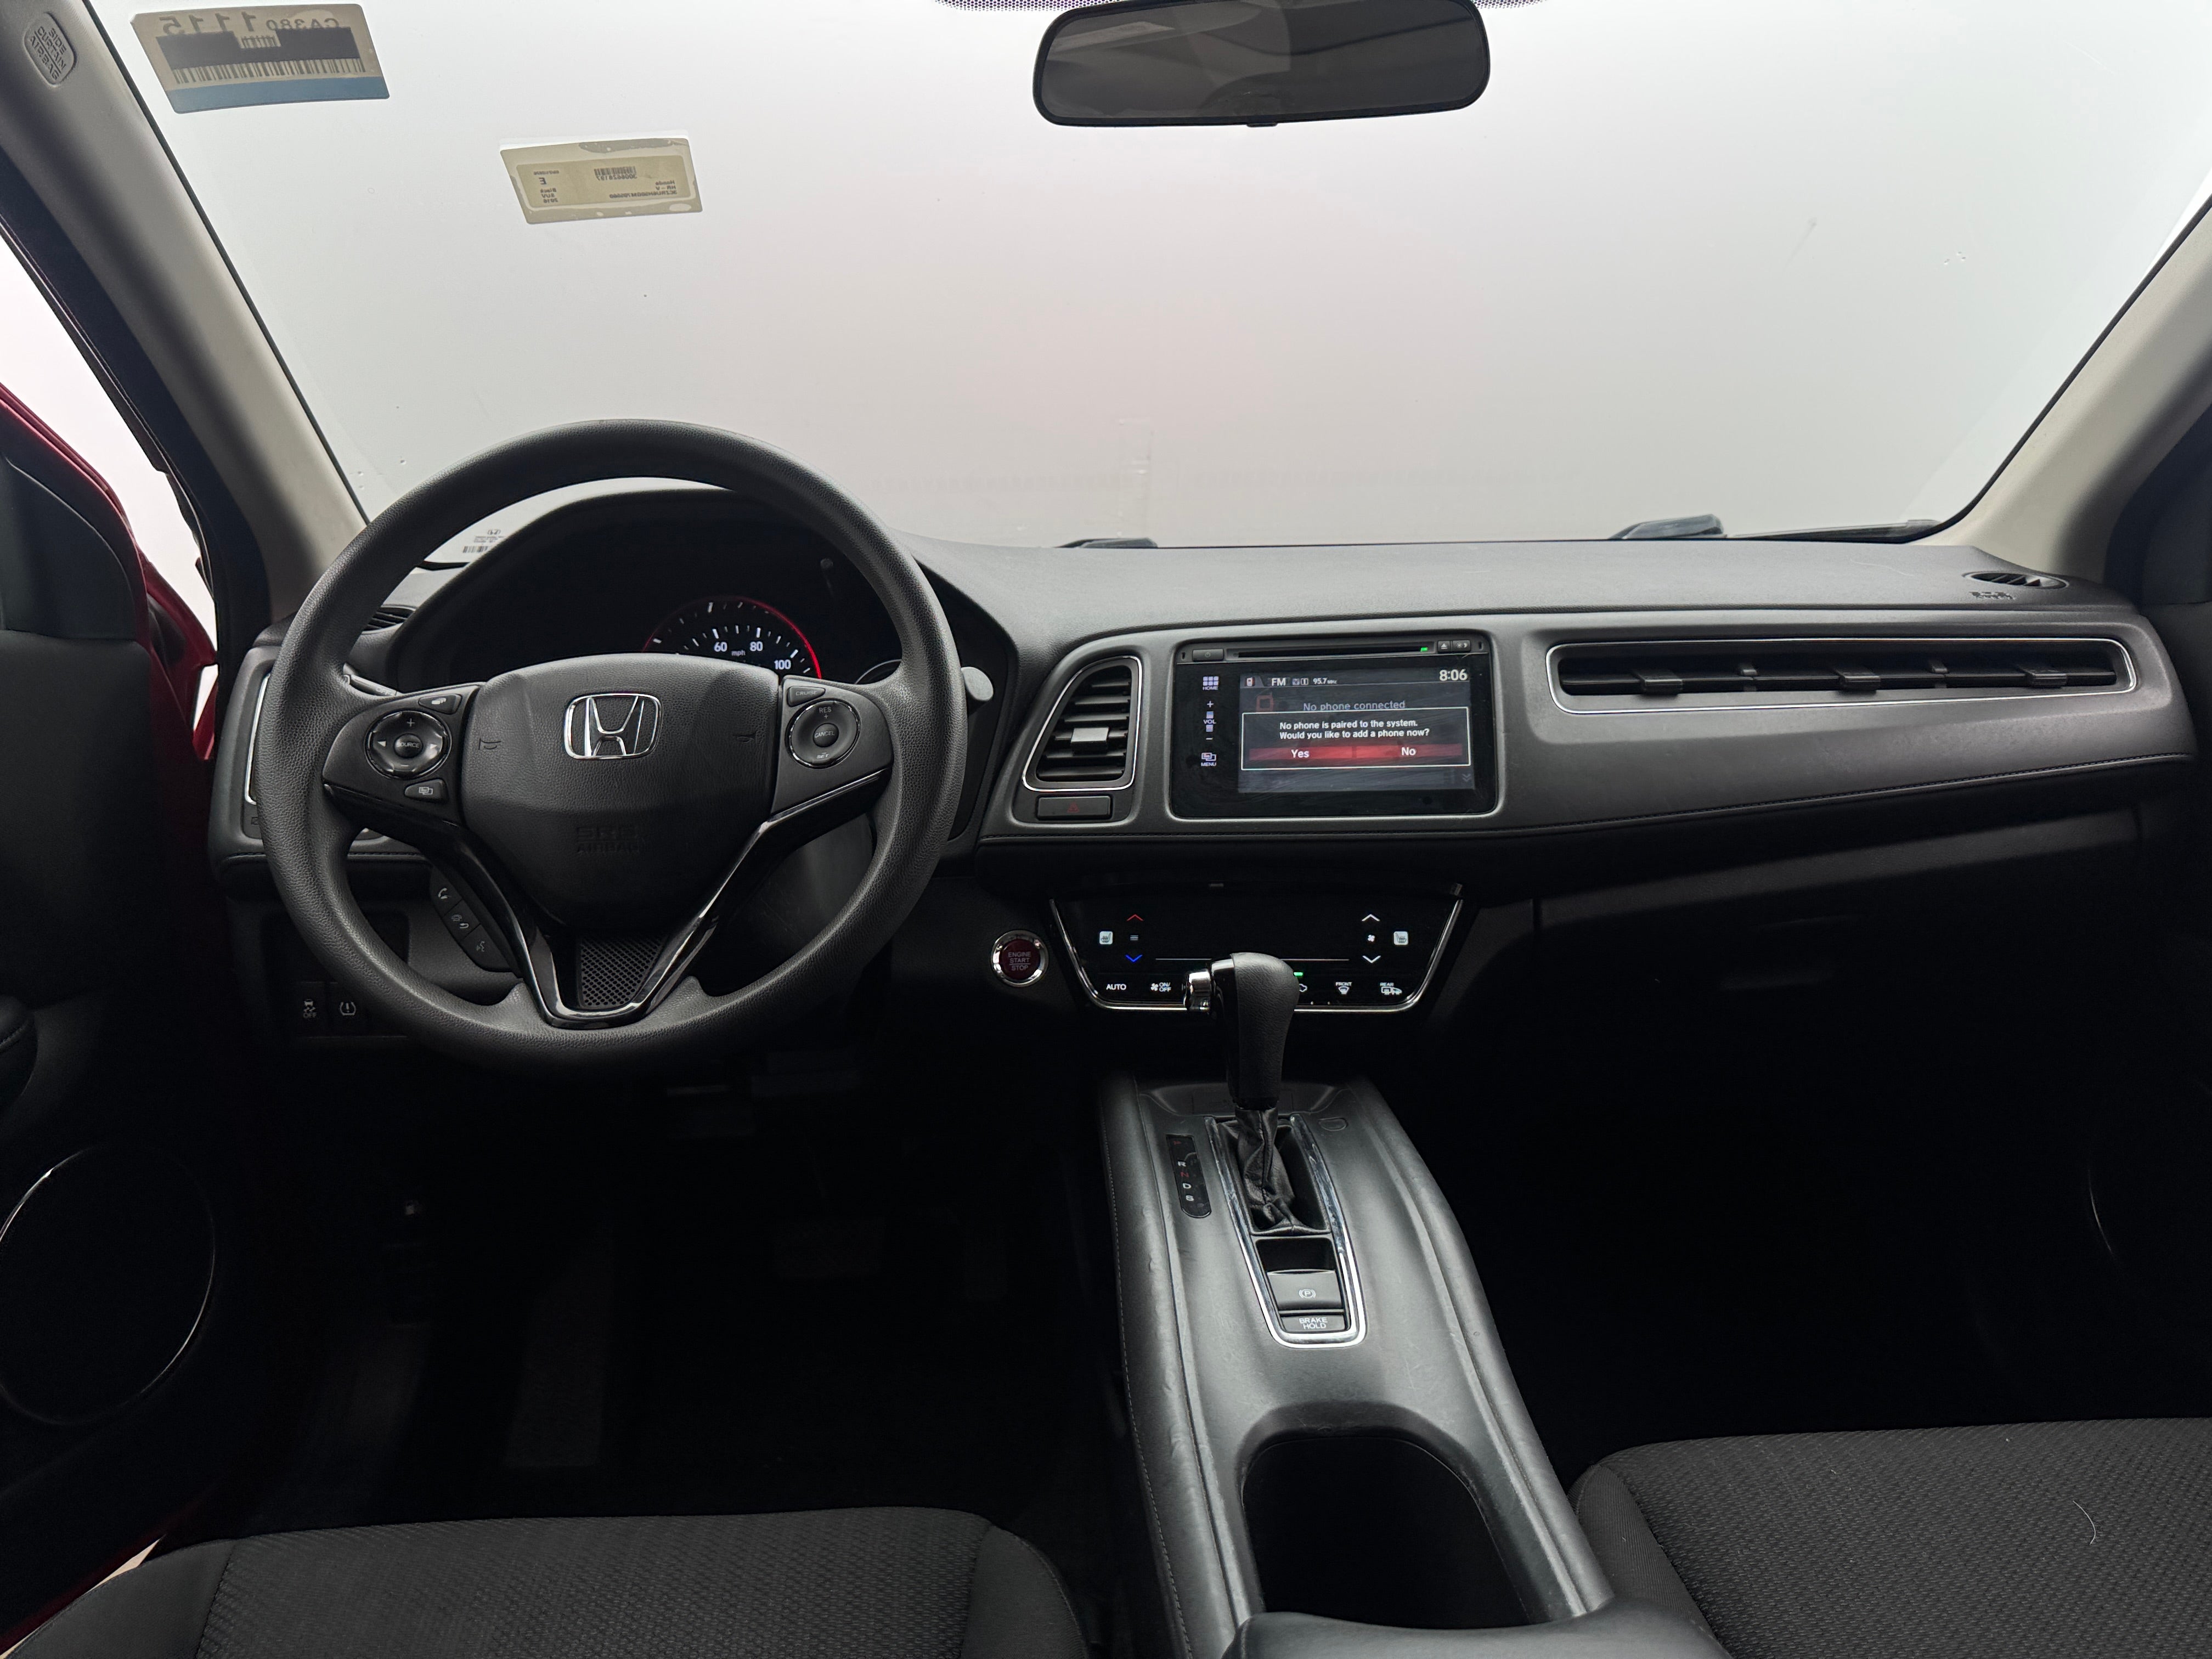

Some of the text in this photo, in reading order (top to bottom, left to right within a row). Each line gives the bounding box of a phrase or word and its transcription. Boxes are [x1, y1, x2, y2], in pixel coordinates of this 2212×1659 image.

[48, 27, 67, 55] SIDE
[37, 26, 66, 70] CURTAIN
[30, 36, 59, 80] AIRBAG
[714, 641, 763, 652] 60 80
[774, 659, 791, 670] 100
[1439, 669, 1468, 681] 8:06
[1271, 678, 1286, 686] FM
[1304, 700, 1406, 711] No phone connected
[1294, 721, 1320, 730] phone
[1331, 720, 1358, 729] paired
[1359, 719, 1368, 728] to
[1370, 719, 1384, 727] the
[1386, 719, 1418, 728] system.
[1279, 731, 1305, 740] Would
[1324, 730, 1340, 738] like
[1352, 730, 1368, 738] add
[1378, 729, 1404, 738] phone
[1406, 728, 1430, 736] now?
[1291, 747, 1417, 758] Yes No
